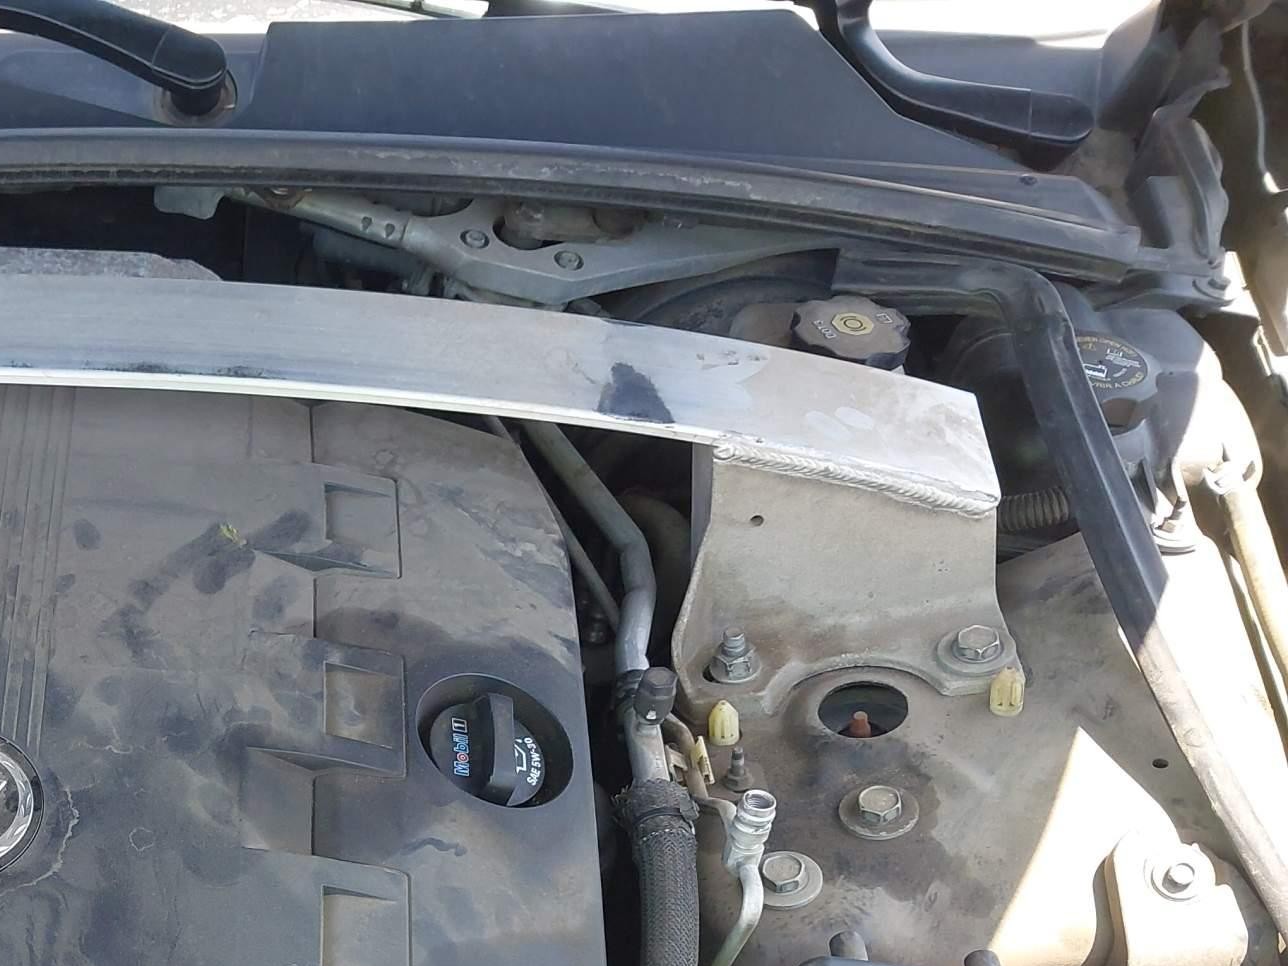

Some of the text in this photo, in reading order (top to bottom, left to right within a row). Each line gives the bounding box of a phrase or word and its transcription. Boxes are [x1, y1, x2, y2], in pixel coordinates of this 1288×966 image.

[452, 732, 470, 777] Mobil
[523, 737, 541, 786] SAE 5W-30
